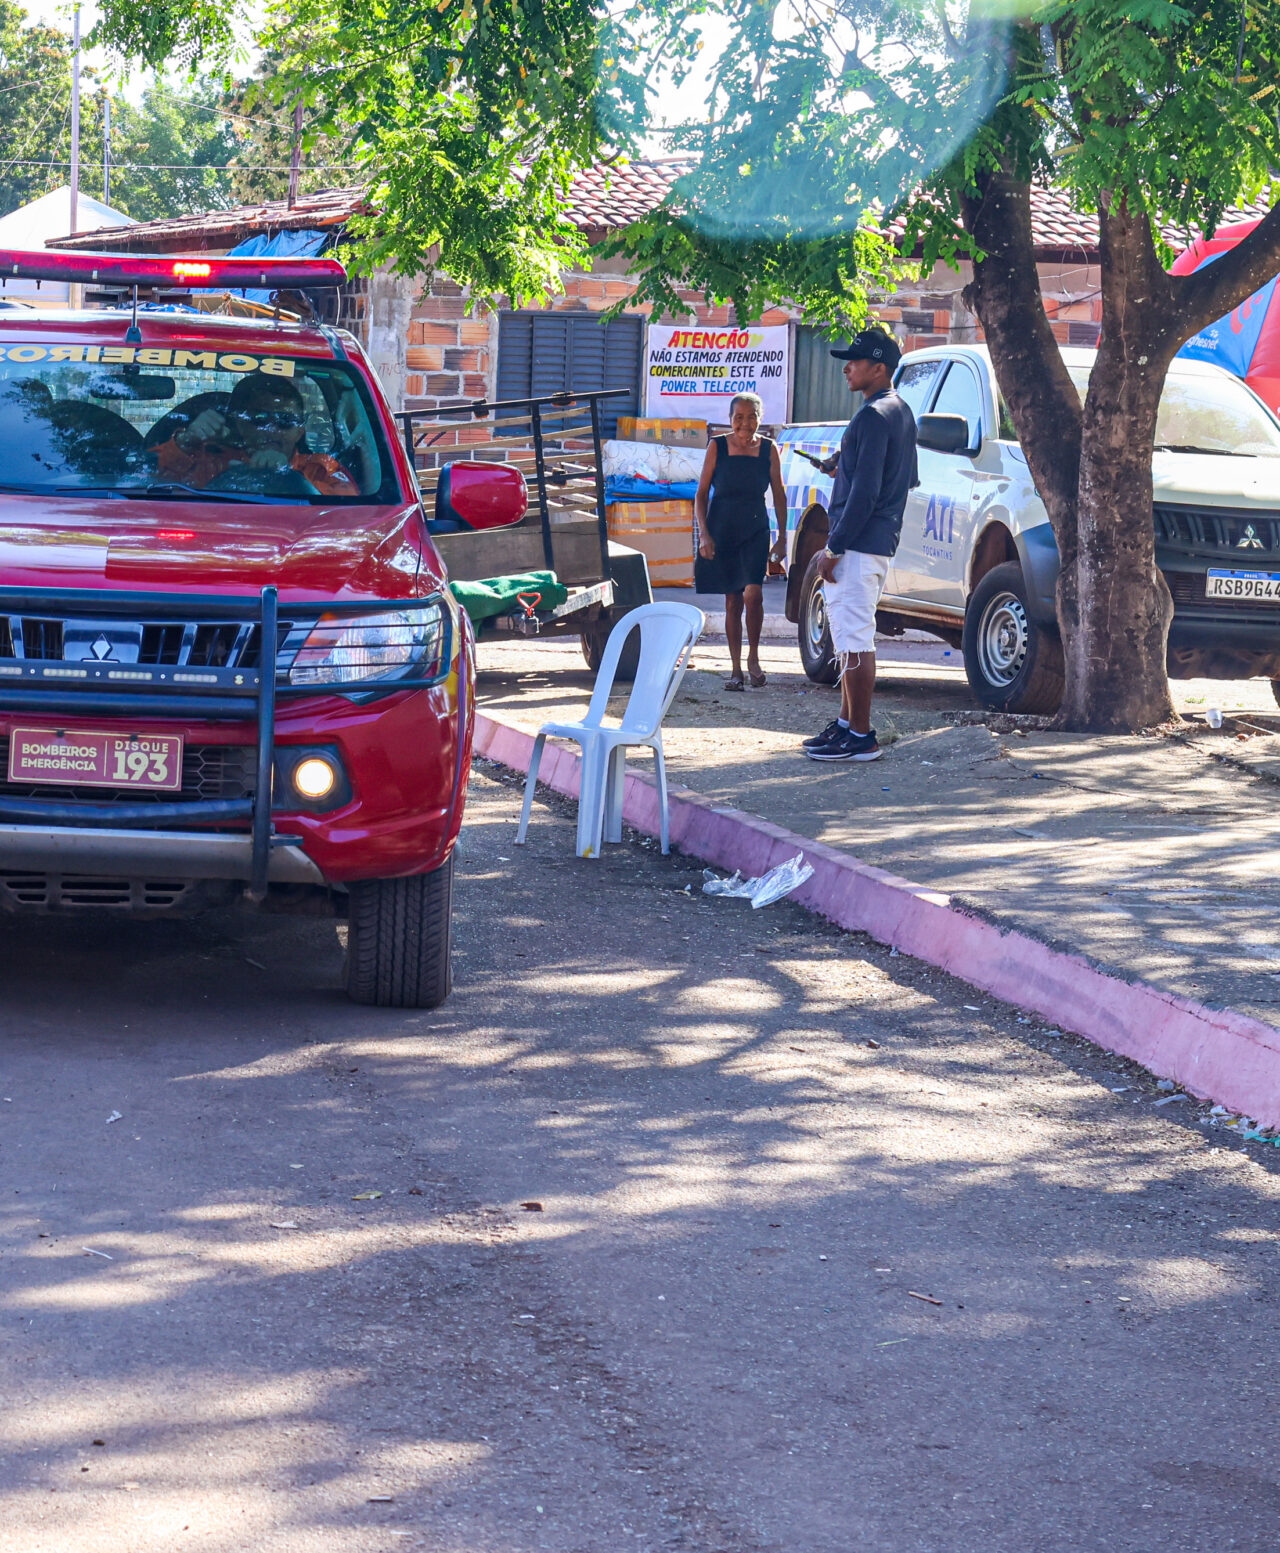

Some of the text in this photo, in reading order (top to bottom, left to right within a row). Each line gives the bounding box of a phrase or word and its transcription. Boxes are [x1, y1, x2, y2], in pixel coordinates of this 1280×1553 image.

[650, 348, 784, 363] NÃO ESTAMOS ATENDENDO
[649, 365, 783, 378] COMERCIANTES ESTE ANO
[660, 380, 757, 393] POWER TELECOM
[923, 493, 956, 544] ATI
[922, 544, 953, 561] TOCANTINS
[1214, 579, 1280, 597] RSB9G44
[21, 743, 97, 758] BOMBEIROS
[115, 740, 169, 753] DISQUE
[20, 757, 97, 771] EMERGÊNCIA
[112, 751, 168, 783] 193
